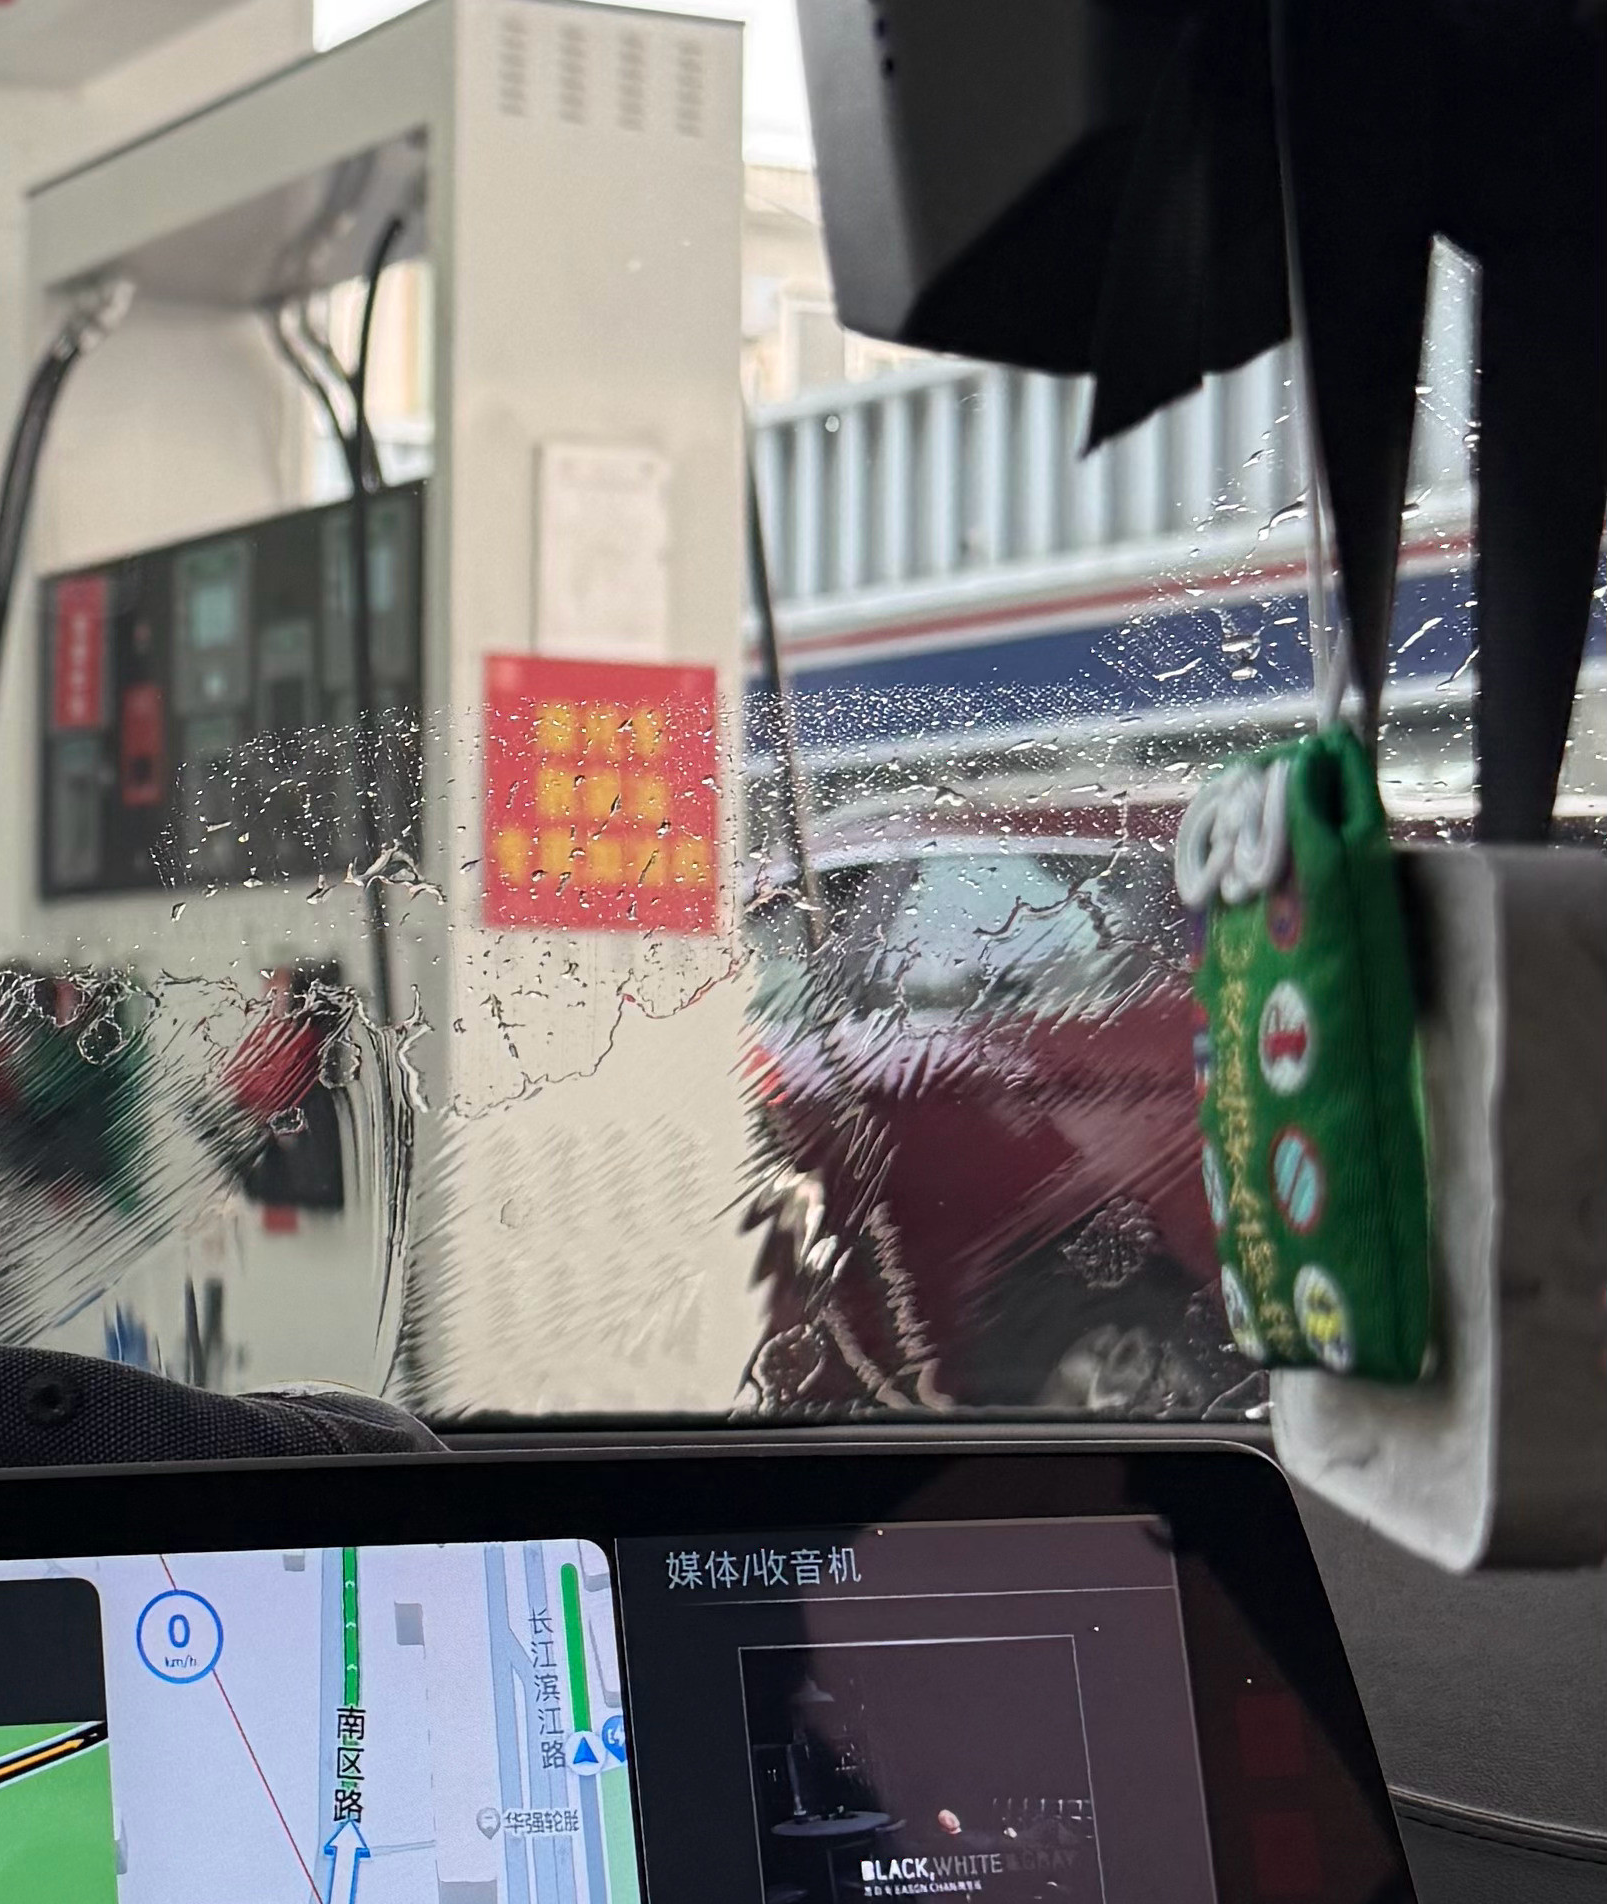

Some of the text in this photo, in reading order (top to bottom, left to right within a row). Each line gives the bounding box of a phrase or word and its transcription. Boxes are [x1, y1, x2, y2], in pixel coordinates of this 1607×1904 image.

[665, 1545, 862, 1590] 媒体/收音机
[168, 1614, 191, 1649] 0
[528, 1607, 567, 1770] 长江滨江路
[333, 1705, 367, 1824] 南区路
